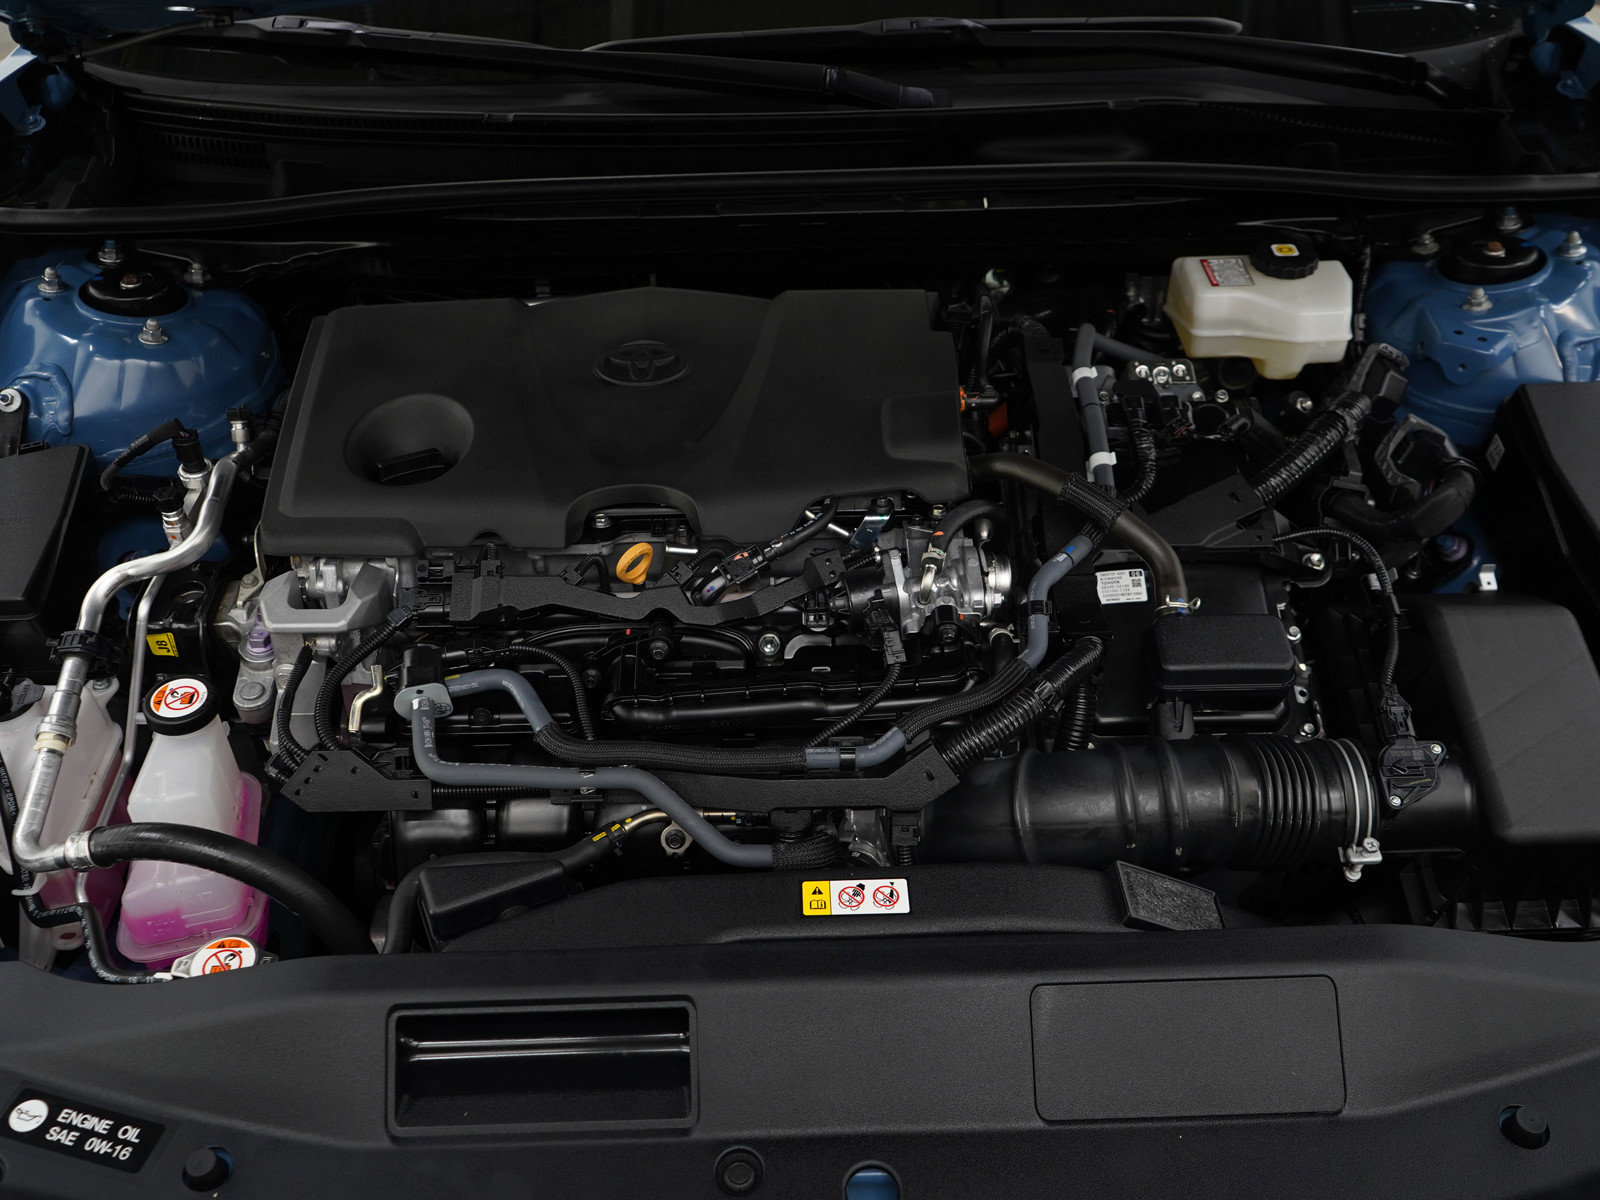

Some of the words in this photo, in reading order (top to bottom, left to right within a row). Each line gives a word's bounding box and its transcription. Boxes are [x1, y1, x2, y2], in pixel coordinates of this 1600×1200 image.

[156, 640, 170, 653] J8
[45, 1126, 81, 1146] SAE
[84, 1137, 134, 1160] 0W-16
[56, 1108, 115, 1134] ENGINE
[117, 1125, 142, 1144] OIL
